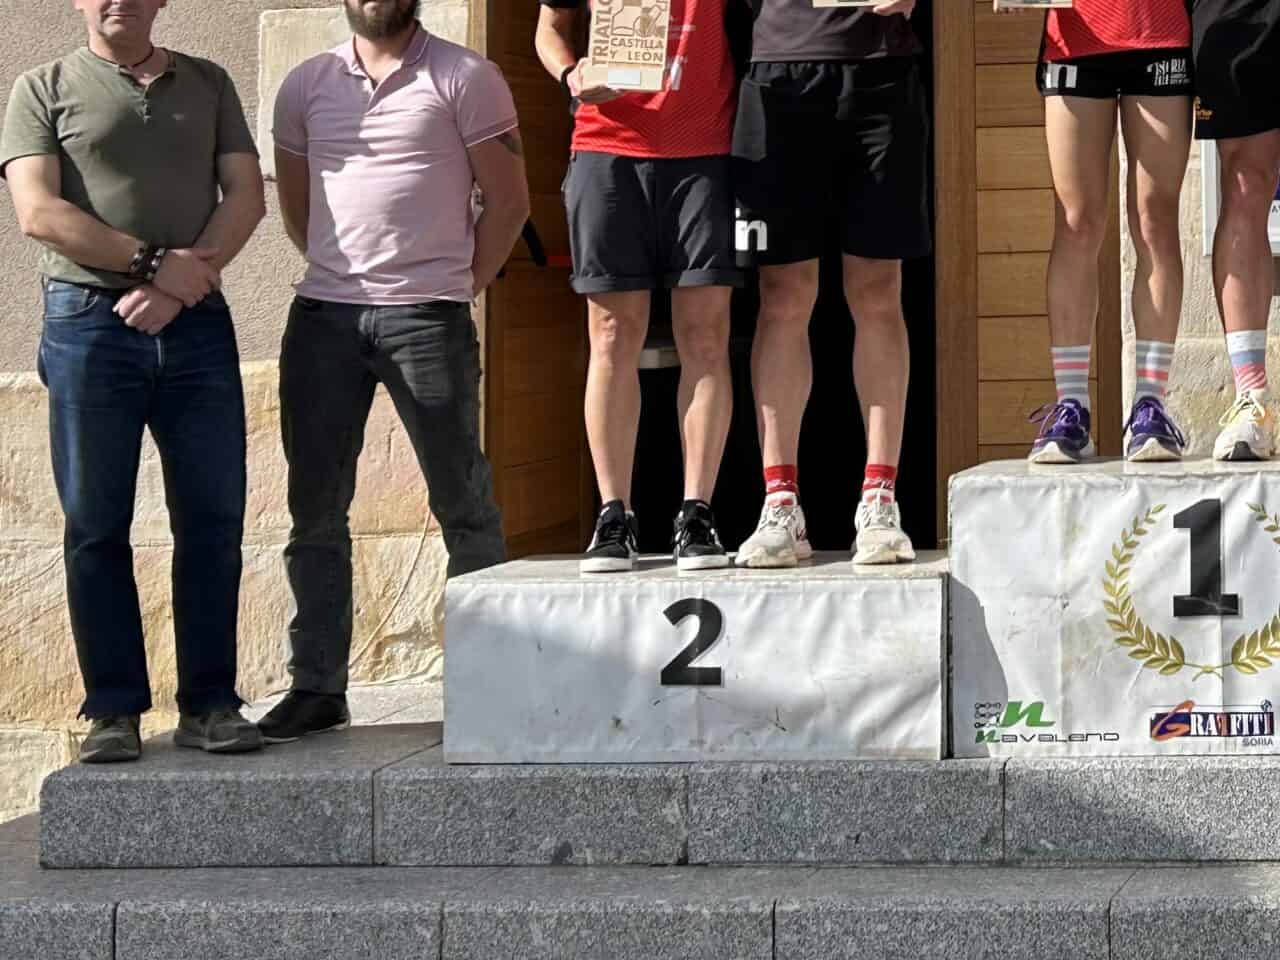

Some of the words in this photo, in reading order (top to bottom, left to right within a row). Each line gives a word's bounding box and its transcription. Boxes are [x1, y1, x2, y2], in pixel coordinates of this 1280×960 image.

[610, 38, 664, 49] CASTILLA
[610, 50, 617, 59] Y
[1173, 499, 1239, 617] 1
[660, 598, 723, 686] 2
[1242, 737, 1274, 747] SORIA
